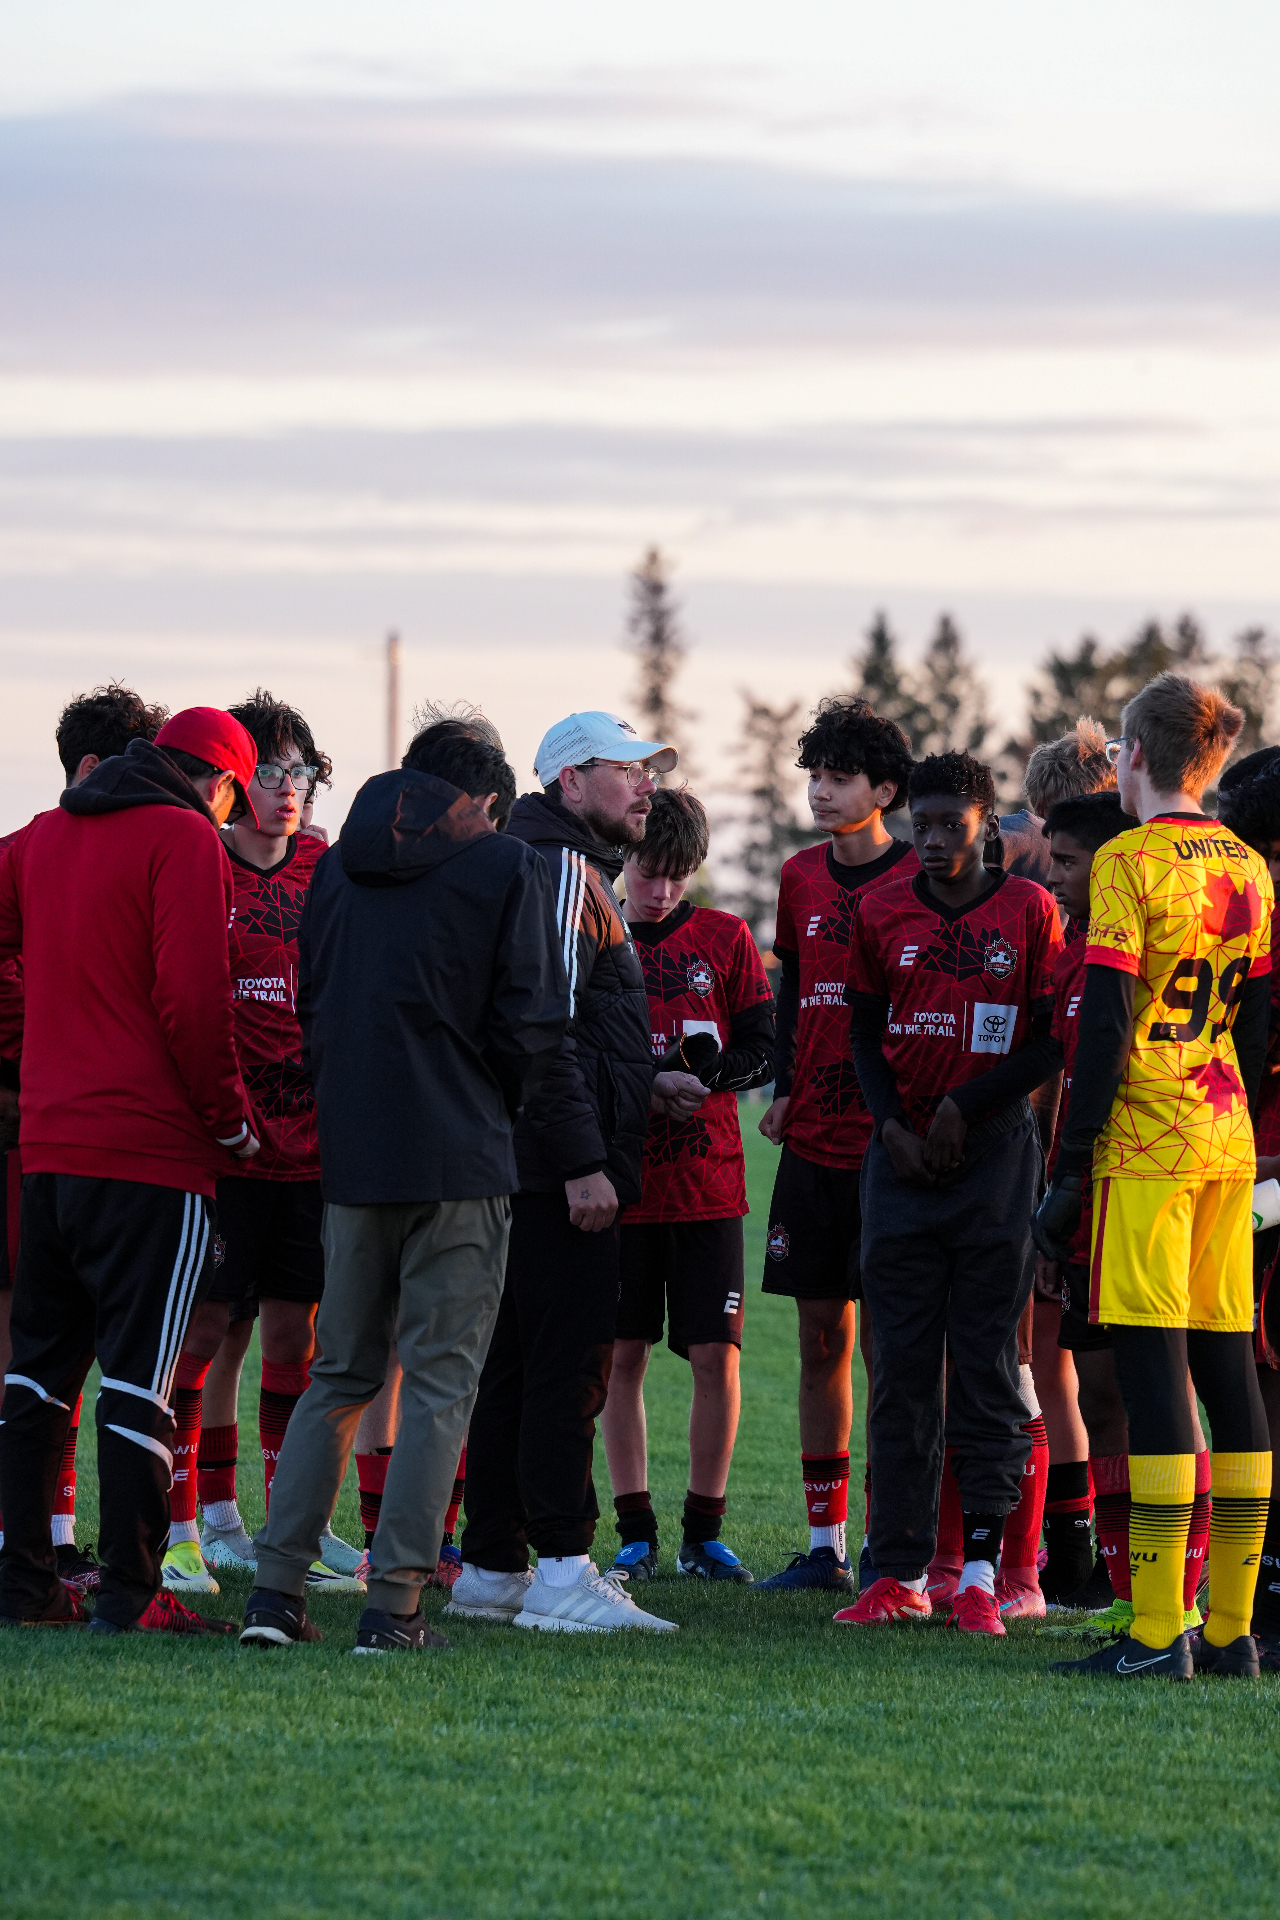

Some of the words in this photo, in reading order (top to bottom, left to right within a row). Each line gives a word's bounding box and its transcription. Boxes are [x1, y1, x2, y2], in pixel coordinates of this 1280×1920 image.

[1173, 838, 1248, 860] UNITED
[237, 977, 286, 989] TOYOTA
[232, 989, 249, 999] HE
[252, 990, 286, 1001] TRAIL
[913, 1011, 956, 1024] TOYOTA
[888, 1022, 901, 1034] ON
[904, 1023, 921, 1034] THE
[923, 1024, 955, 1036] TRAIL
[804, 1479, 842, 1491] SWU
